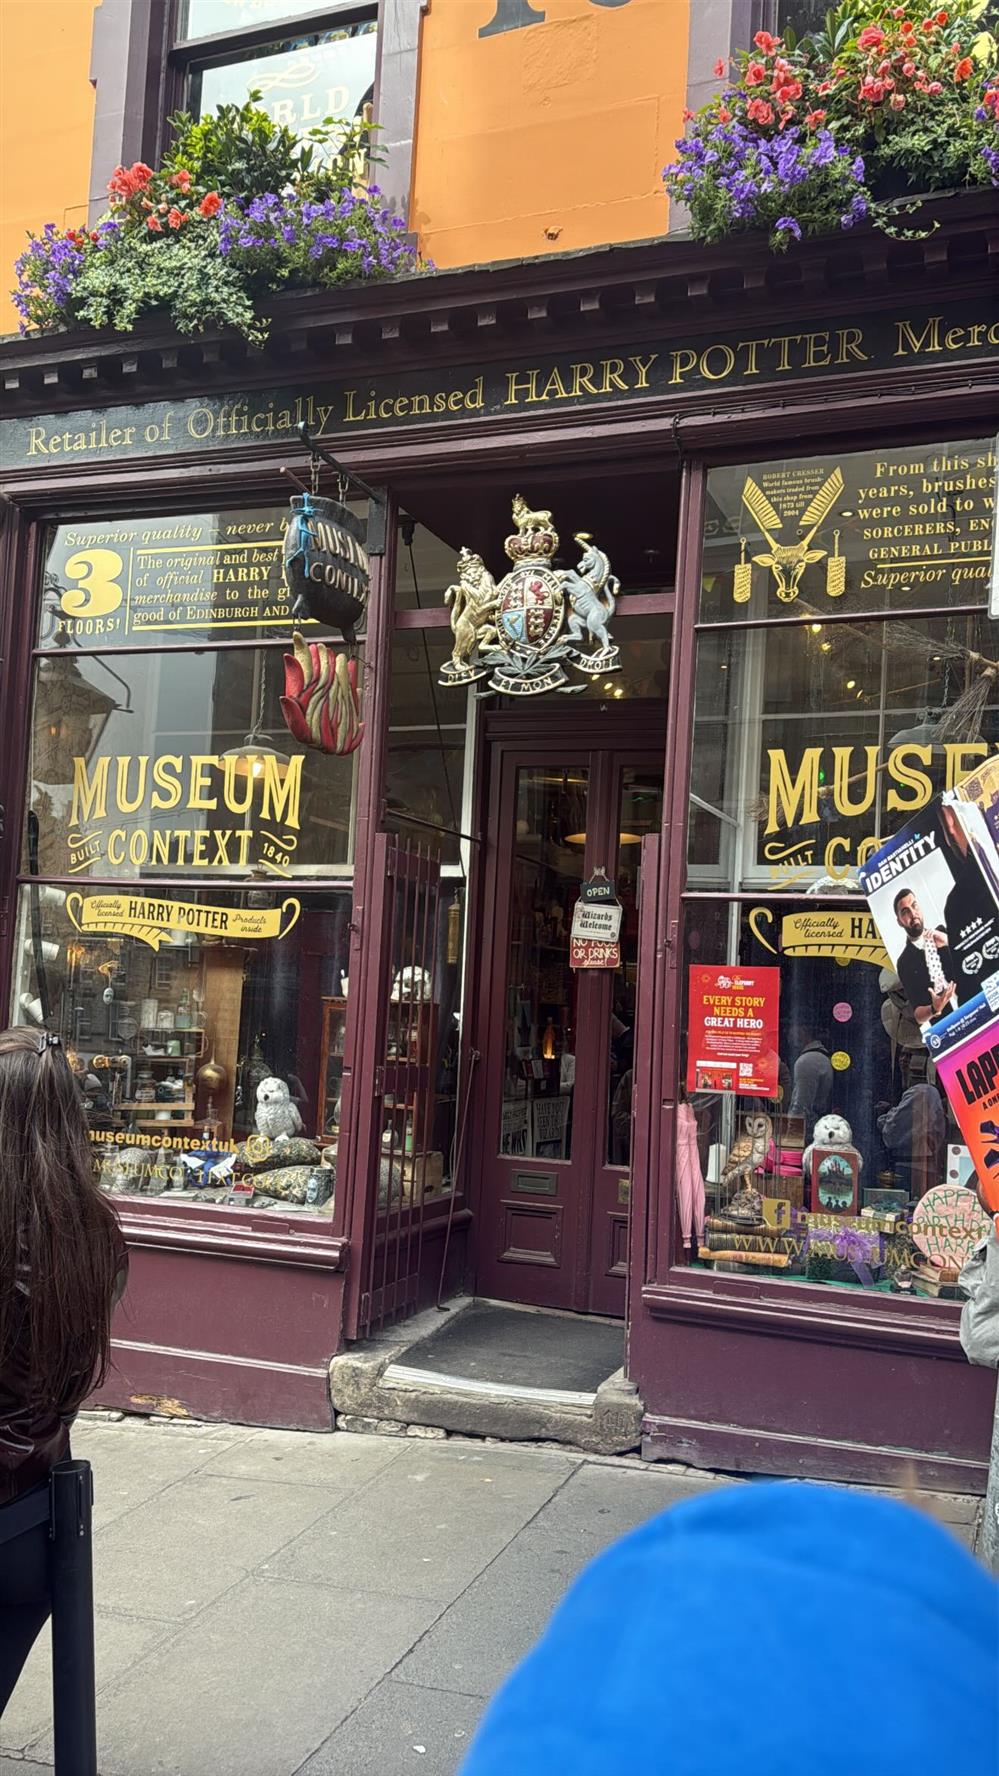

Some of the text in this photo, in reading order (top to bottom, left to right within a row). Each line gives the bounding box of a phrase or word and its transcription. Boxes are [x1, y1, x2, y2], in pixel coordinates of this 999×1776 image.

[26, 420, 136, 456] Retailer
[144, 411, 175, 442] of
[187, 395, 334, 439] Officially
[343, 376, 485, 422] Licensed
[503, 353, 659, 406] HARRY
[668, 328, 869, 384] POTTER
[875, 462, 924, 478] From
[933, 455, 969, 472] this
[858, 473, 996, 503] years, brushes
[857, 505, 901, 520] were
[908, 497, 947, 515] sold
[955, 498, 974, 511] to
[64, 530, 138, 549] Superior
[142, 525, 204, 544] quality
[226, 521, 274, 536] never
[863, 518, 993, 540] SORCERERS, EN
[137, 549, 278, 570] The original and best
[869, 543, 943, 560] GENERAL
[61, 549, 123, 618] 3
[136, 566, 272, 589] of official HARRY
[860, 565, 947, 590] Superior
[134, 589, 218, 606] merchandise
[226, 587, 239, 600] to
[247, 585, 269, 599] the
[57, 618, 121, 635] FLOORS!
[133, 607, 164, 626] good
[168, 607, 183, 621] of
[520, 676, 553, 692] MON
[68, 754, 306, 831] MUSEUM
[69, 828, 291, 868] BUILT CONTEXT 1840
[865, 830, 937, 893] IDENTITY
[586, 886, 611, 897] OPEN
[90, 899, 122, 910] Officially
[128, 900, 174, 922] HARRY
[177, 906, 229, 930] POTTER
[581, 911, 613, 922] Wizards
[793, 916, 840, 931] Officially
[580, 920, 613, 931] Welcome
[803, 928, 845, 938] licensed
[572, 947, 619, 960] OR DRINKS
[703, 995, 766, 1008] EVERY STORY
[713, 1006, 754, 1018] NEEDS A
[704, 1016, 764, 1030] GREAT HERO
